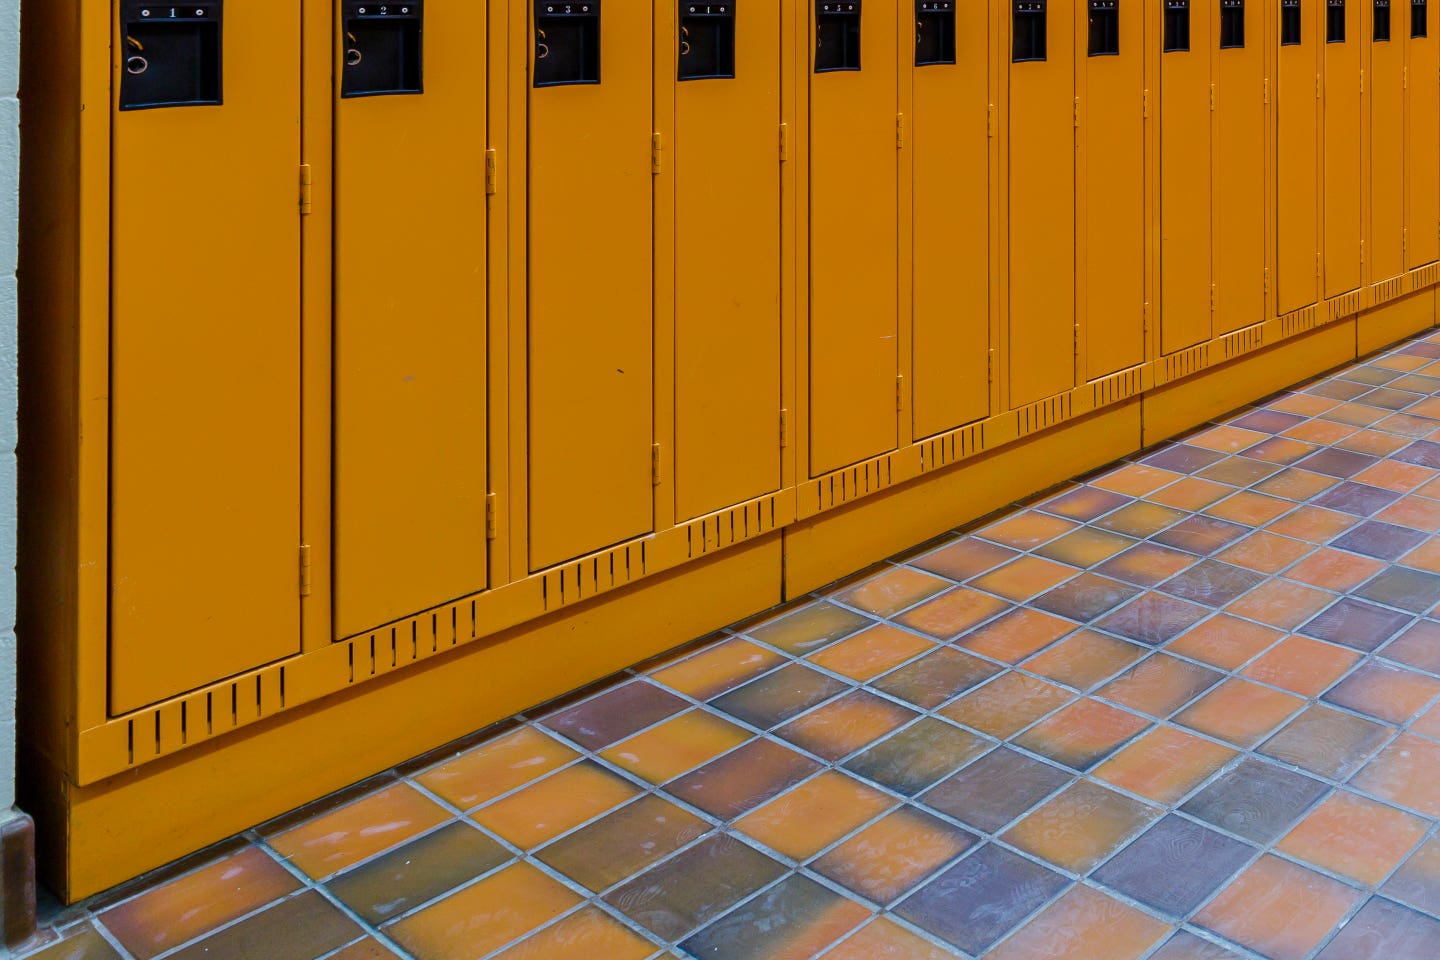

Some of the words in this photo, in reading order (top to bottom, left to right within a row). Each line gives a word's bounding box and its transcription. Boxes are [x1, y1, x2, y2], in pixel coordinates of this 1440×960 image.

[169, 8, 176, 17] 1
[380, 6, 387, 15] 2
[565, 5, 571, 14] 3
